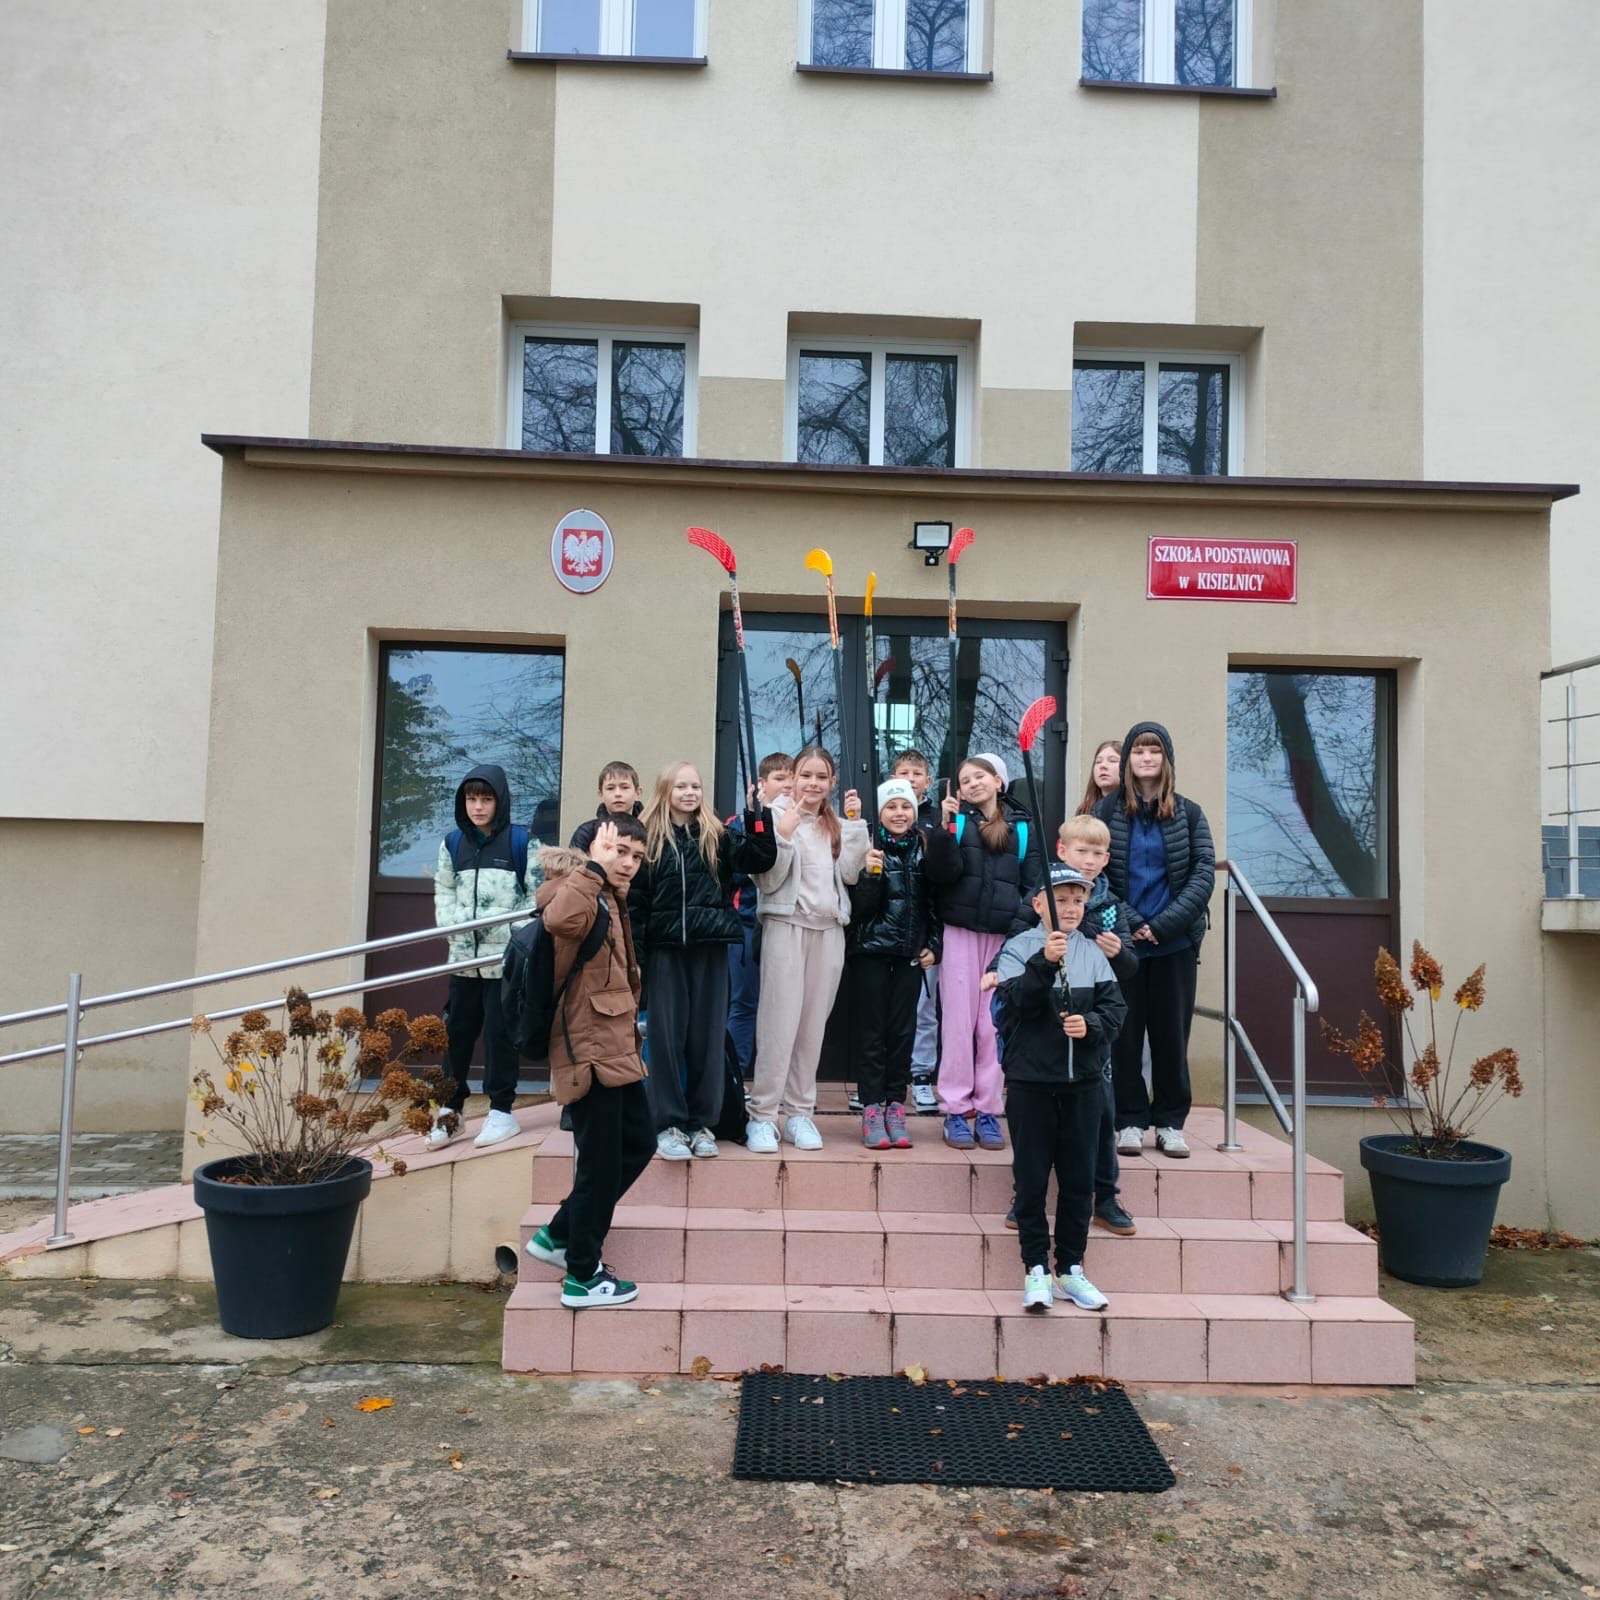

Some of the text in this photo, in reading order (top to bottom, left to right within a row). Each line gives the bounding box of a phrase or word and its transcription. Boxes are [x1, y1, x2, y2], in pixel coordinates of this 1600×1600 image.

[1154, 545, 1291, 566] SZKOŁA PODSTAWOWA
[1197, 572, 1265, 591] KISIELNICY
